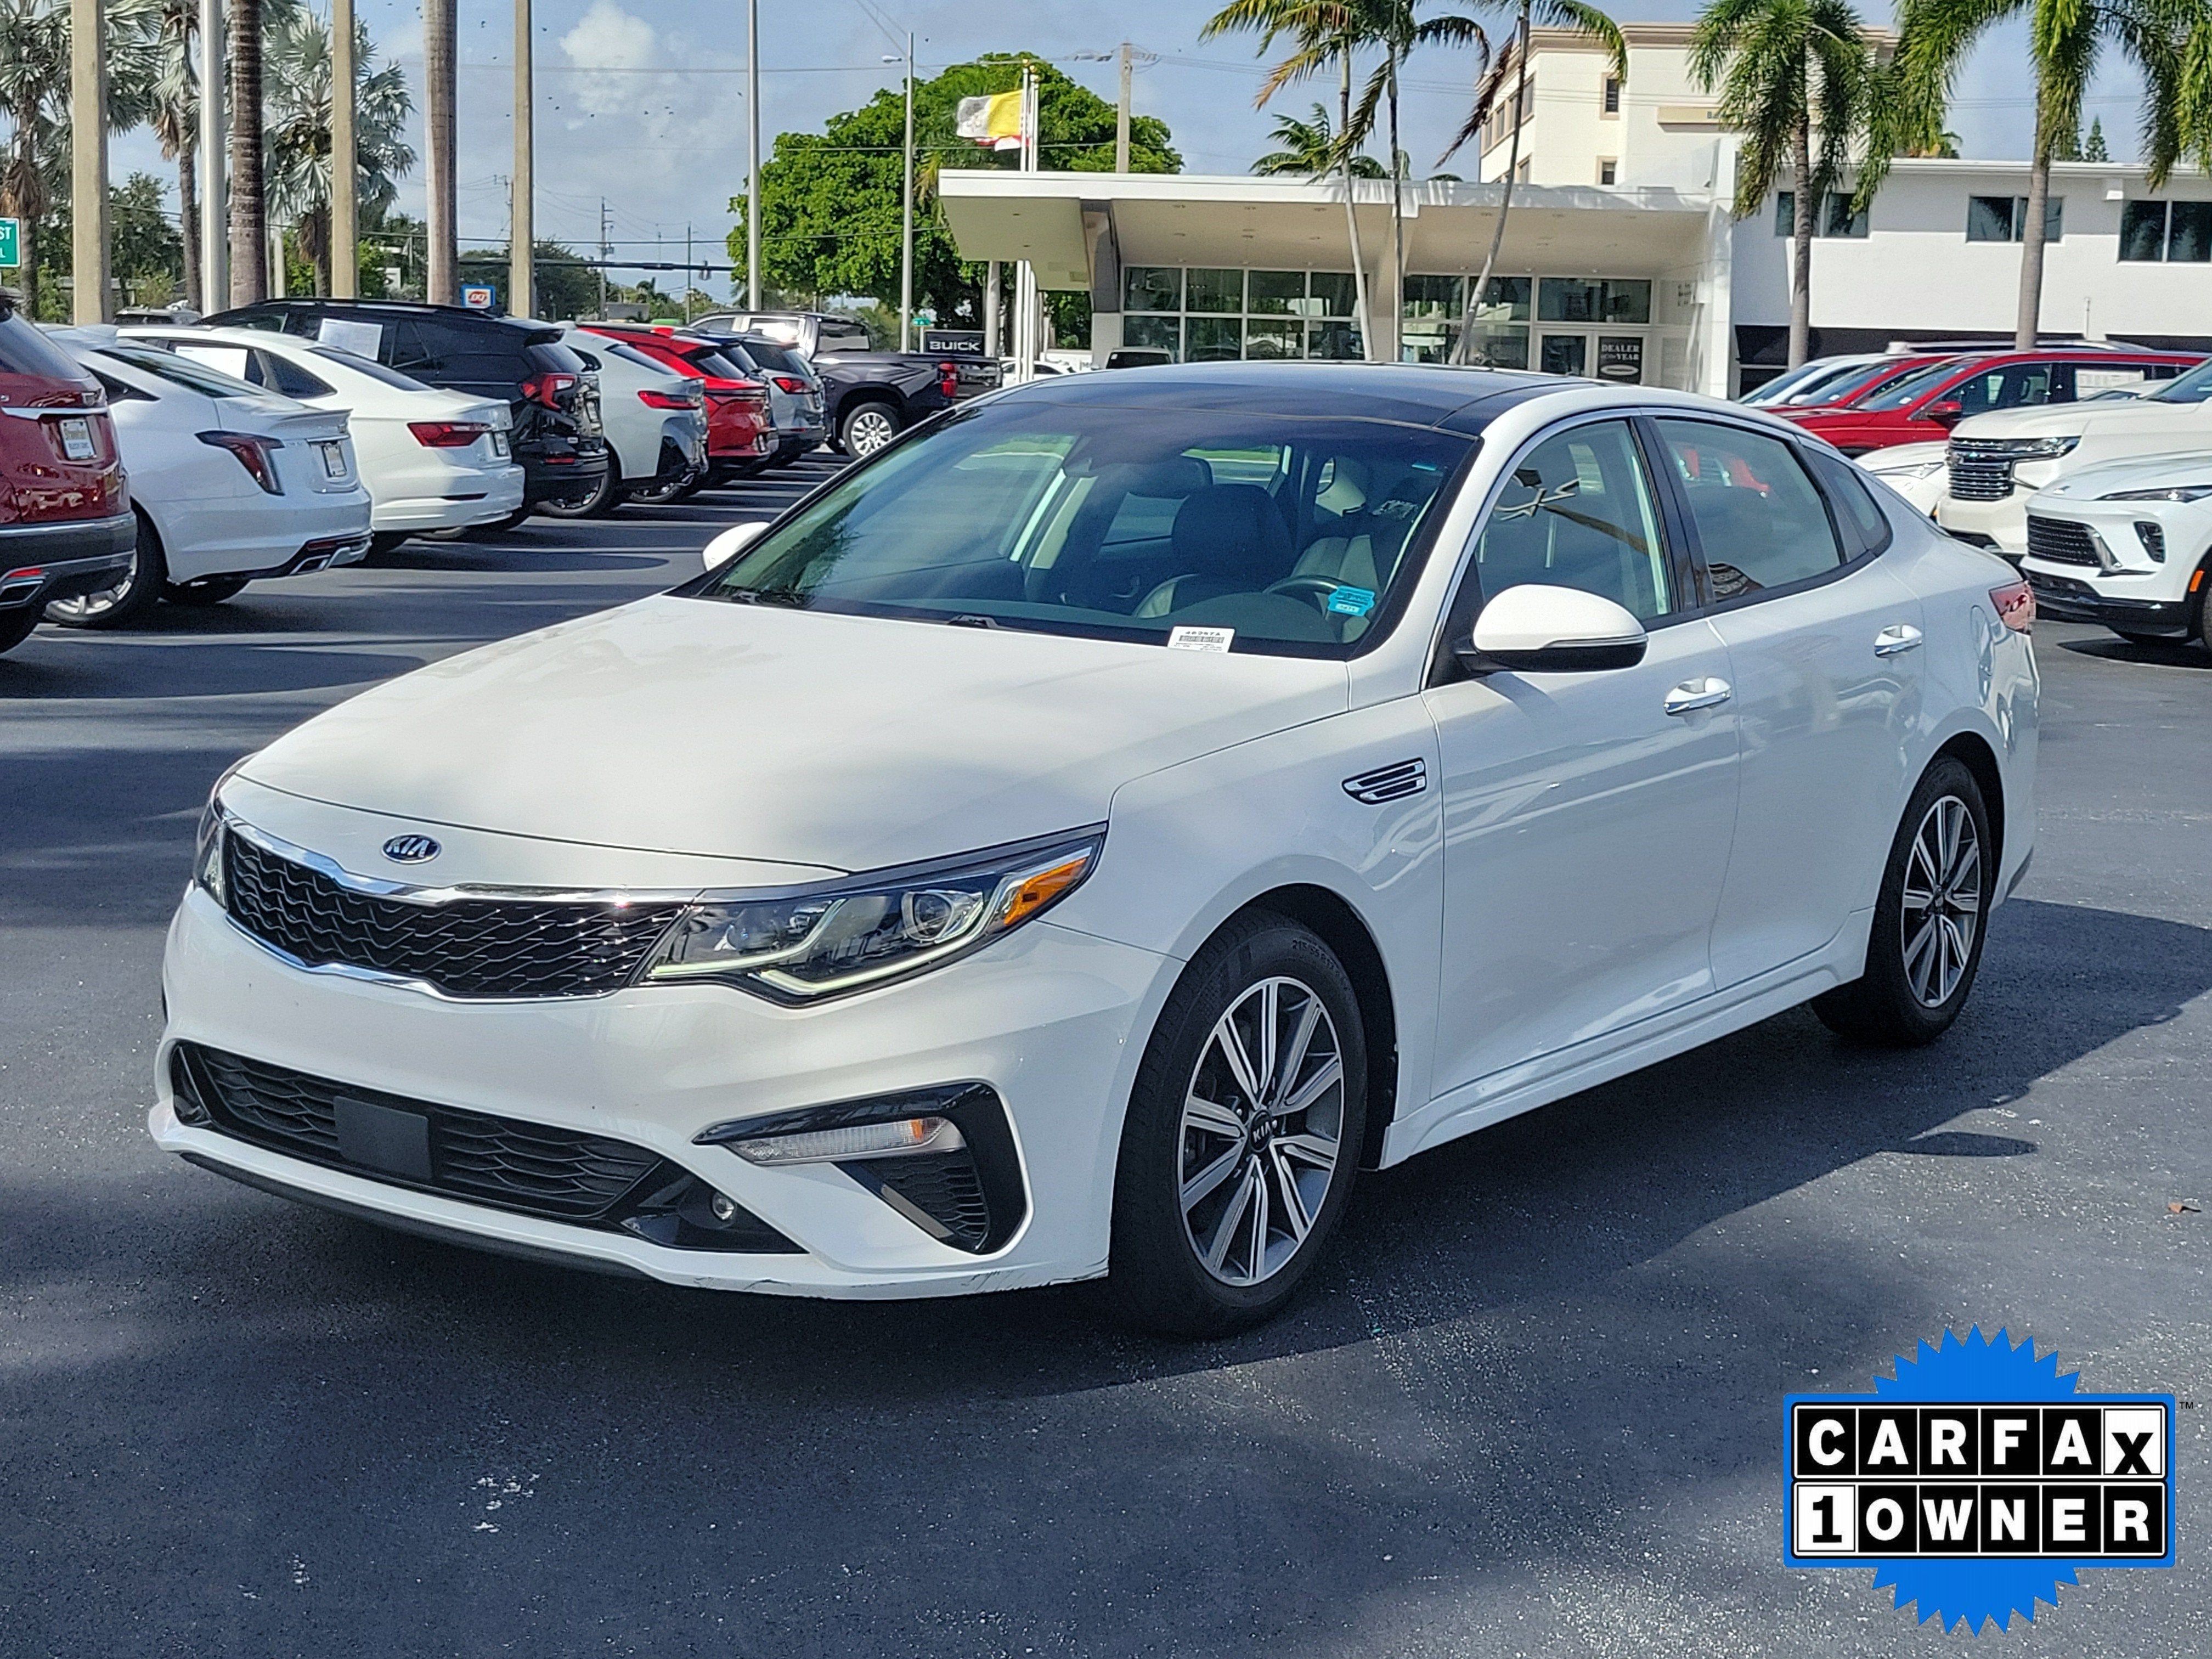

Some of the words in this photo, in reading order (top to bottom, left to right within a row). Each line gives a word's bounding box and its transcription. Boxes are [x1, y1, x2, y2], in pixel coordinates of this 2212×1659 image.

[929, 341, 981, 351] BUICK
[1601, 344, 1640, 353] DEALER
[386, 837, 430, 857] KIA
[1252, 1121, 1271, 1143] KIA
